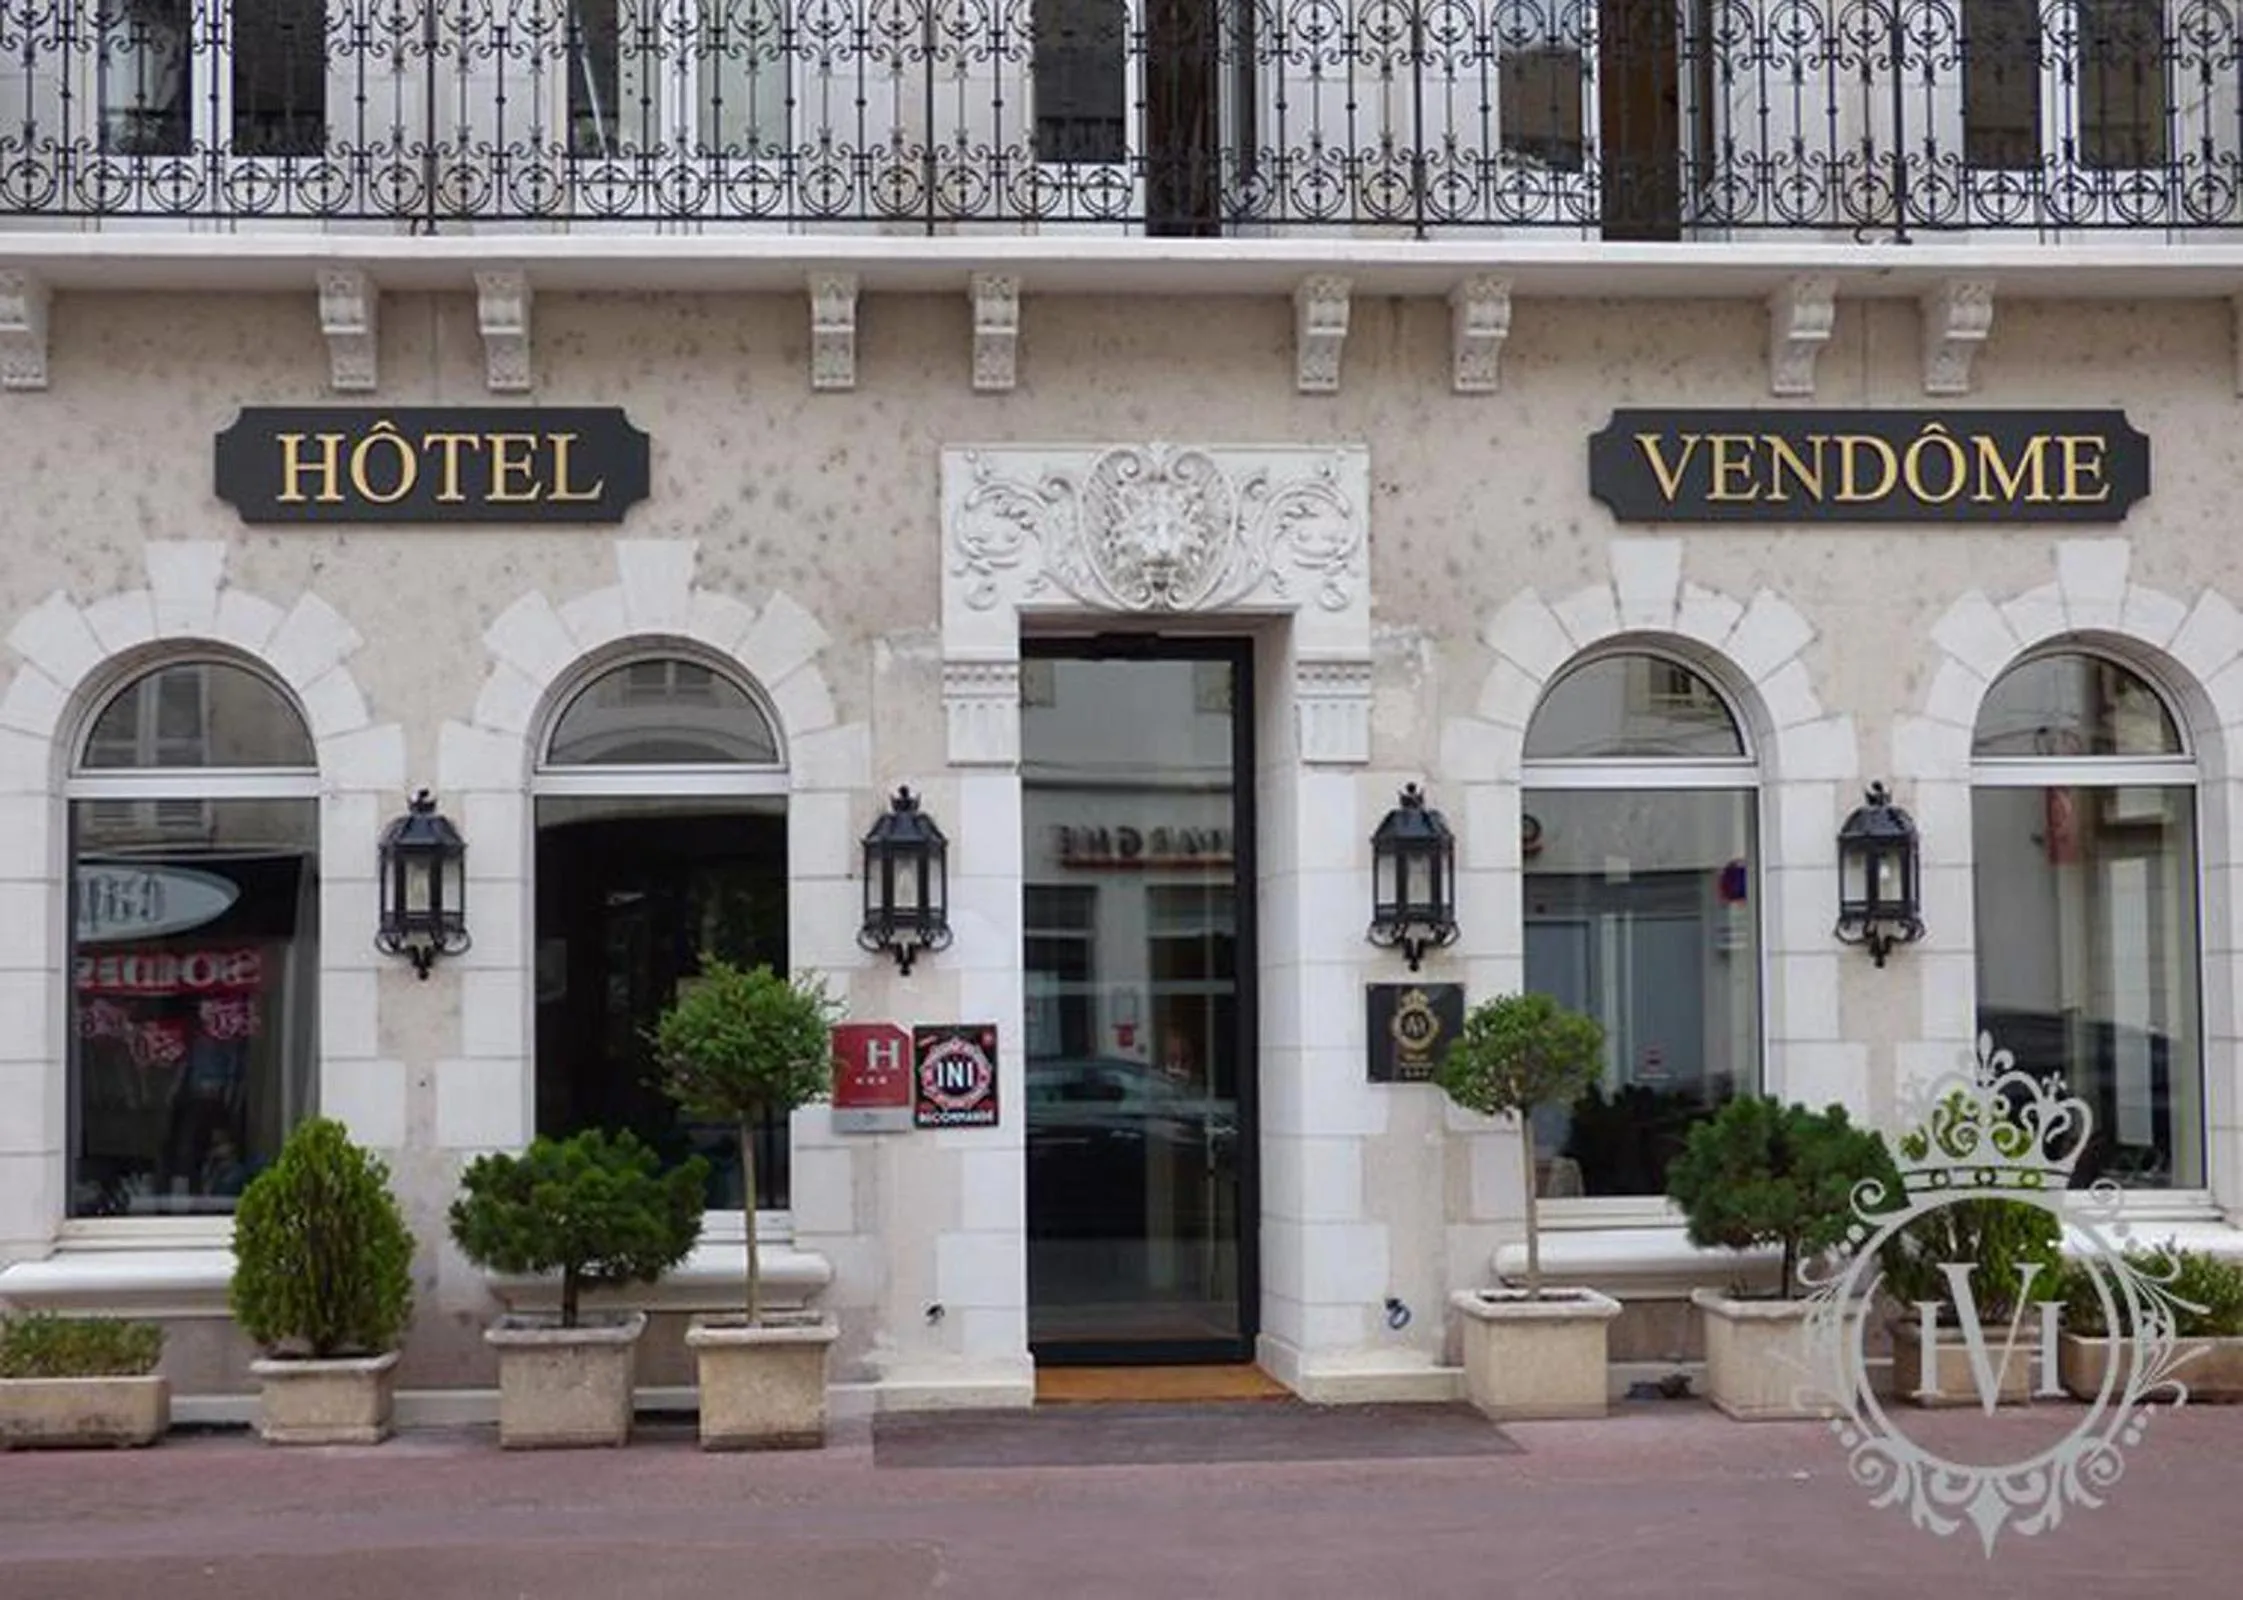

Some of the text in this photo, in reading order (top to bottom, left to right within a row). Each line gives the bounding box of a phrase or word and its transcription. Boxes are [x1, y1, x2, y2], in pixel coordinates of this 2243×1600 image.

[275, 420, 604, 503] HÔTEL
[1634, 421, 2111, 503] VENDÔME
[866, 1038, 900, 1071] H
